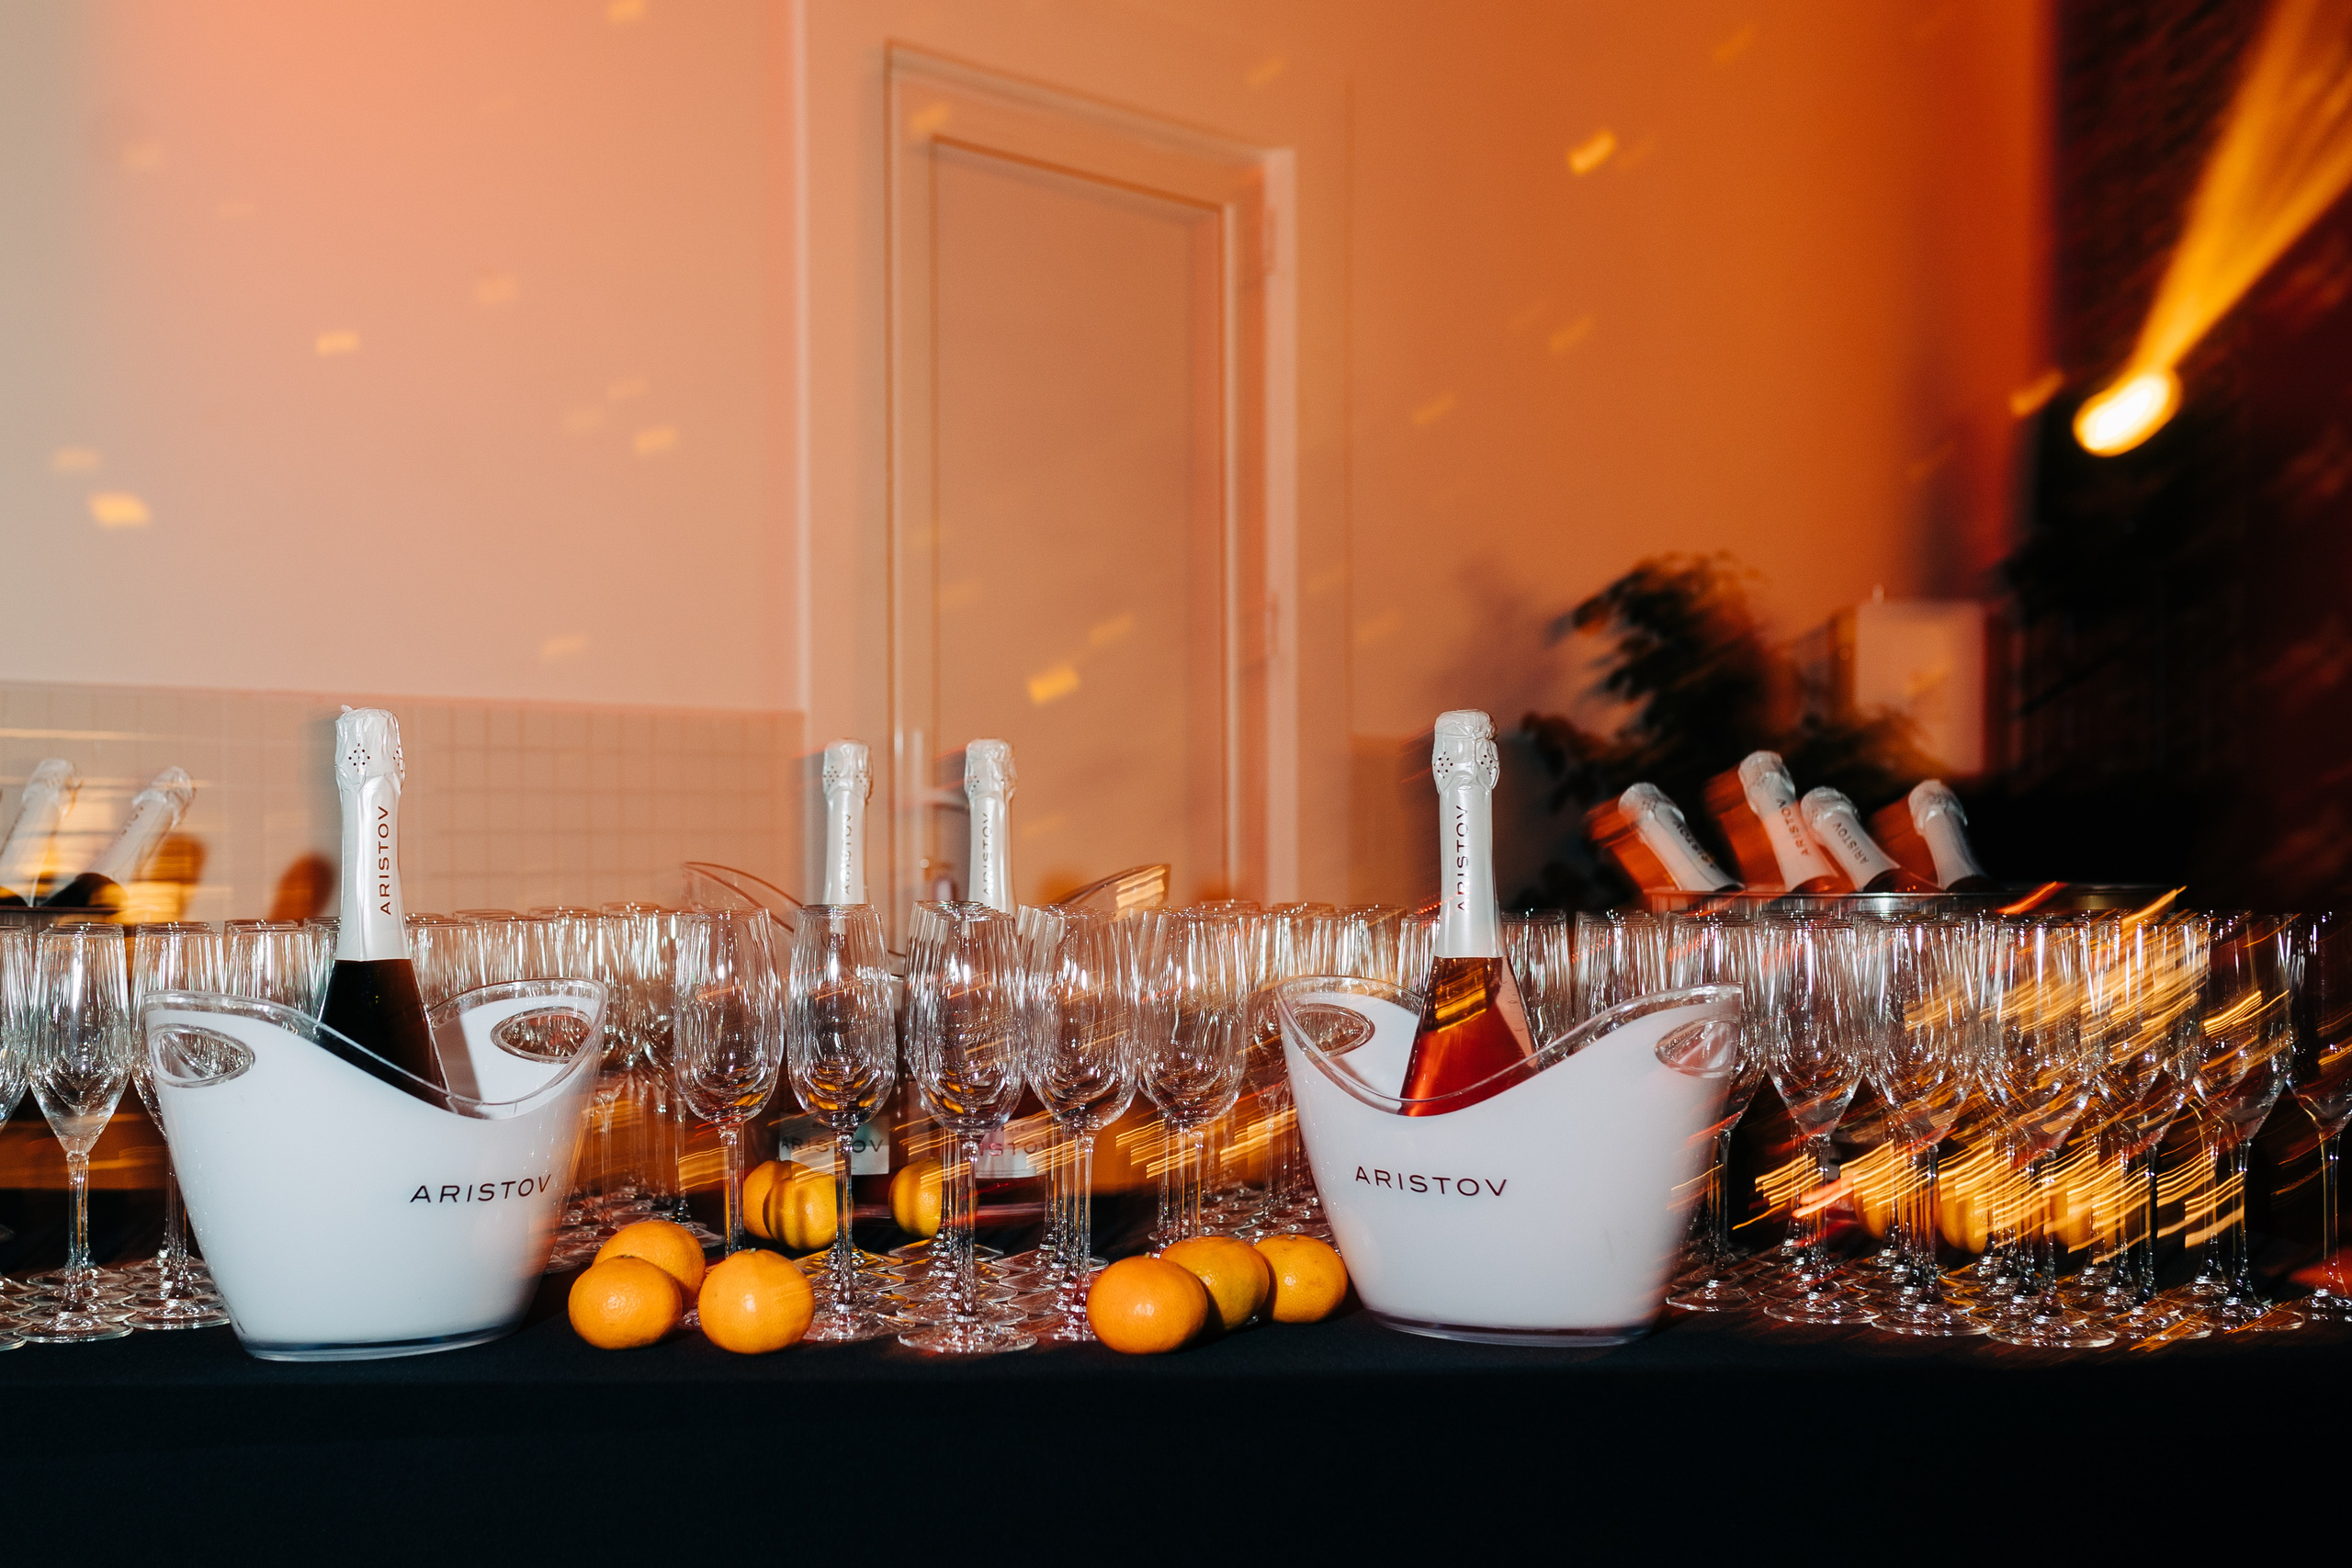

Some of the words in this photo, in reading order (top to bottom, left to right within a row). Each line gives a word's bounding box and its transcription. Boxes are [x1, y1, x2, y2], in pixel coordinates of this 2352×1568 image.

[378, 806, 391, 916] ARISTOV
[1455, 805, 1469, 912] ARISTOV
[1833, 821, 1870, 864] ARISTOV
[410, 1174, 551, 1202] ARISTOV
[1355, 1166, 1507, 1196] ARISTOV
